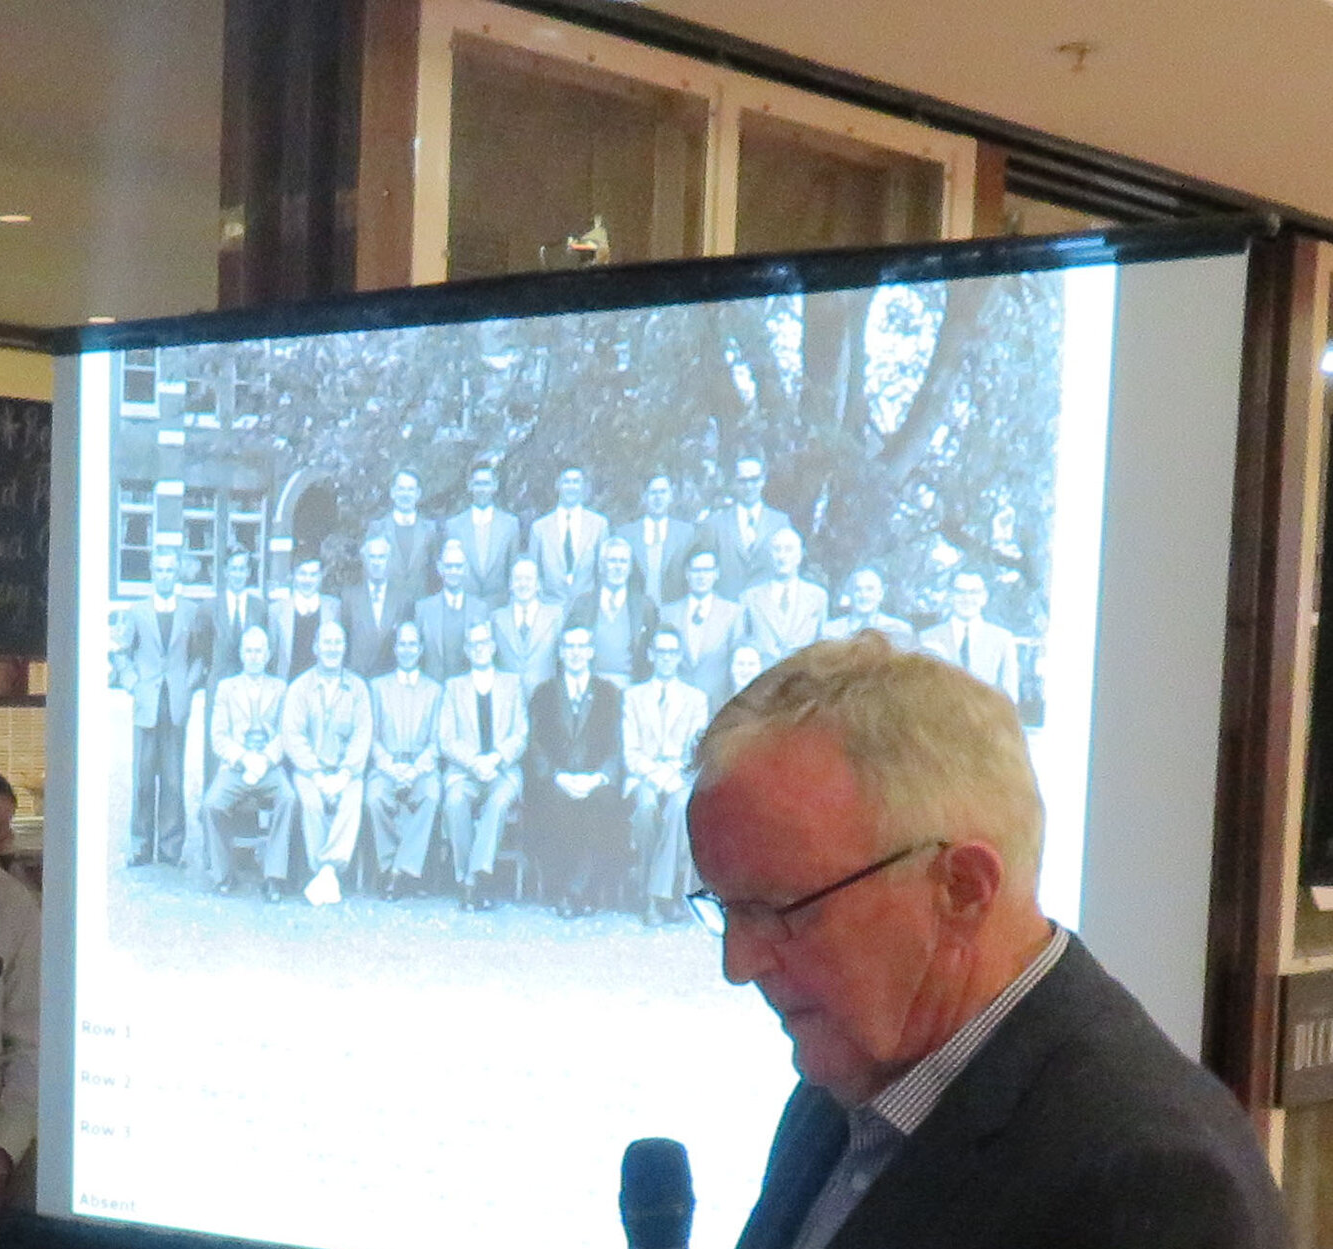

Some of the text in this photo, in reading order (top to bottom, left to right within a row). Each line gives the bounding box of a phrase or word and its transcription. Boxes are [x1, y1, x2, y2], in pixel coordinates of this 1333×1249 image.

[81, 1020, 116, 1037] Row
[80, 1070, 132, 1089] Row 2
[79, 1120, 114, 1137] Row
[79, 1192, 137, 1213] Absent
